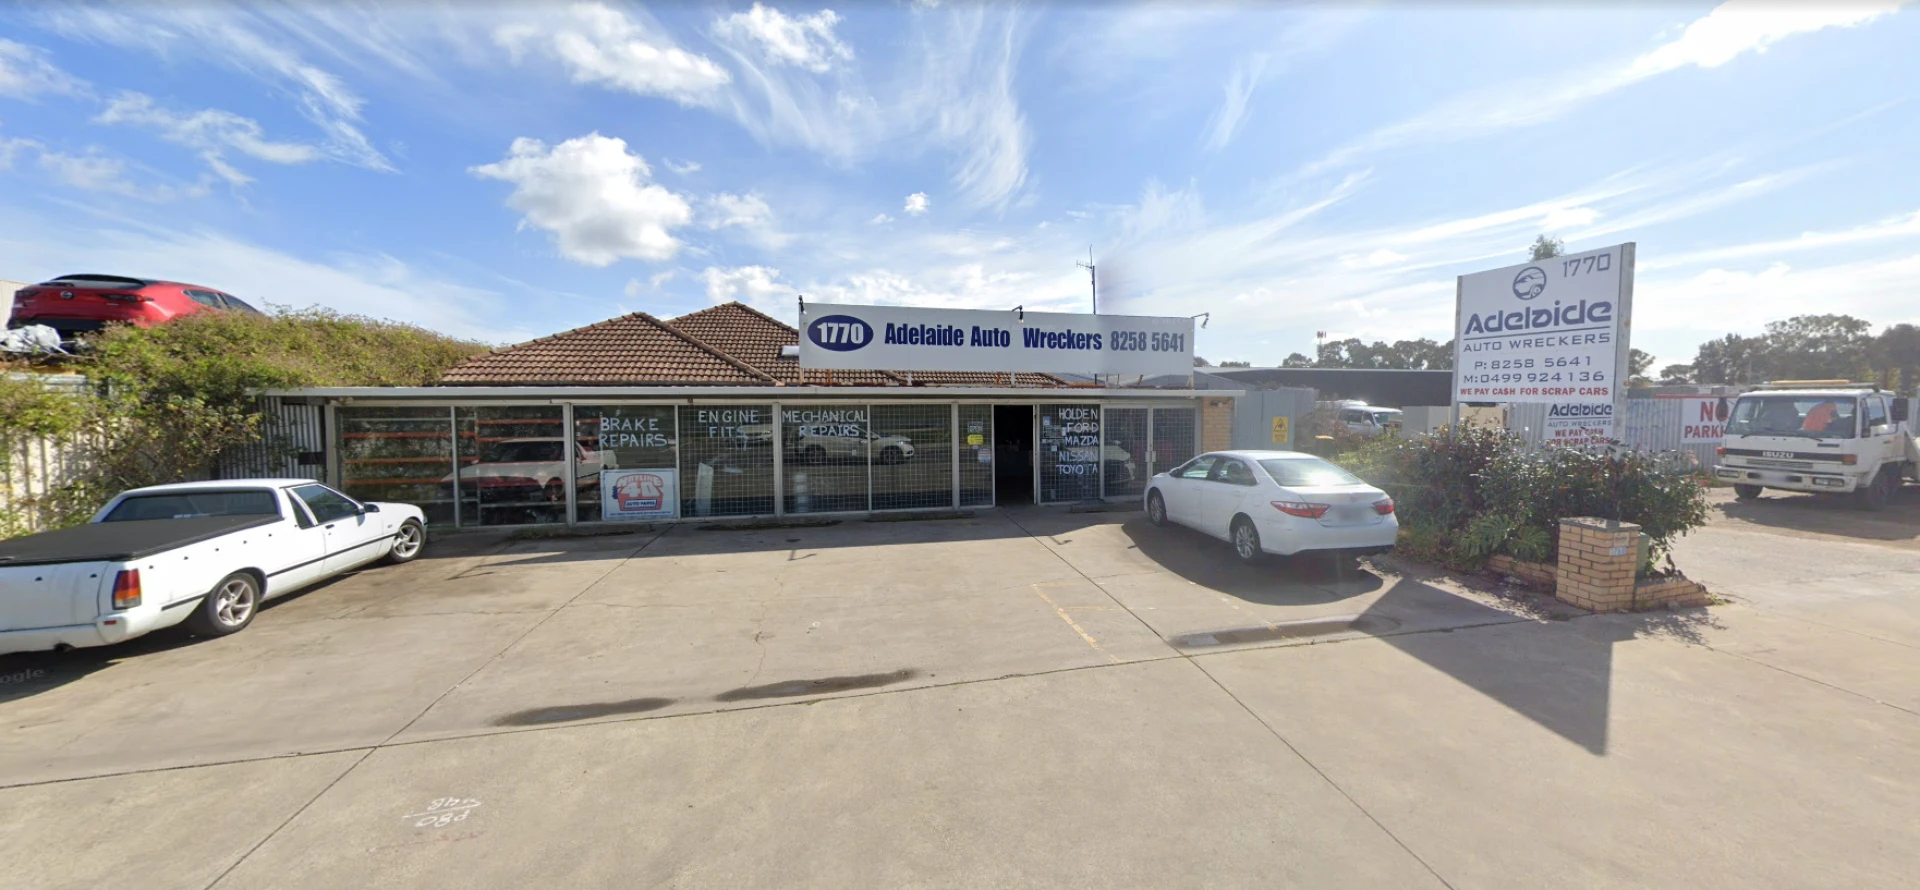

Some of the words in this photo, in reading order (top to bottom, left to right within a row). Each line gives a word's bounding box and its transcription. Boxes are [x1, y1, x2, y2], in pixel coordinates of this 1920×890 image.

[1562, 253, 1611, 278] 1770
[1464, 299, 1612, 335] Adelaide
[817, 322, 864, 345] 1770
[884, 323, 965, 347] Adelaide
[970, 325, 1011, 348] Auto
[1023, 327, 1103, 350] Wreckers
[1110, 331, 1147, 352] 8258
[1151, 332, 1185, 353] 5641
[1463, 341, 1502, 352] AUTO
[1509, 332, 1610, 349] WRECKERS
[1544, 355, 1591, 368] 5641
[1527, 372, 1562, 383] 924
[1568, 371, 1605, 382] 136
[1460, 388, 1472, 396] WE
[1474, 388, 1490, 396] PAY
[1520, 387, 1539, 396] FOR
[1541, 387, 1576, 396] SCRAP
[1579, 386, 1609, 396] CARS
[782, 410, 868, 423] MECHANICAL
[1059, 408, 1098, 420] HOLDEN
[1548, 403, 1613, 417] Adelaide
[698, 410, 759, 424] ENGINE
[1571, 419, 1612, 427] WRECKERS
[600, 417, 659, 431] BRAKE
[799, 424, 861, 437] REPAIRS
[1066, 422, 1099, 433] FORD
[1555, 429, 1567, 437] WE
[1569, 428, 1583, 437] PAY
[598, 433, 668, 448] REPAIRS
[1065, 435, 1099, 446] MAZDA
[1059, 450, 1099, 462] NISSAN
[1762, 450, 1794, 459] ISUZU
[1056, 463, 1098, 474] TOYOTA
[621, 481, 660, 498] 40
